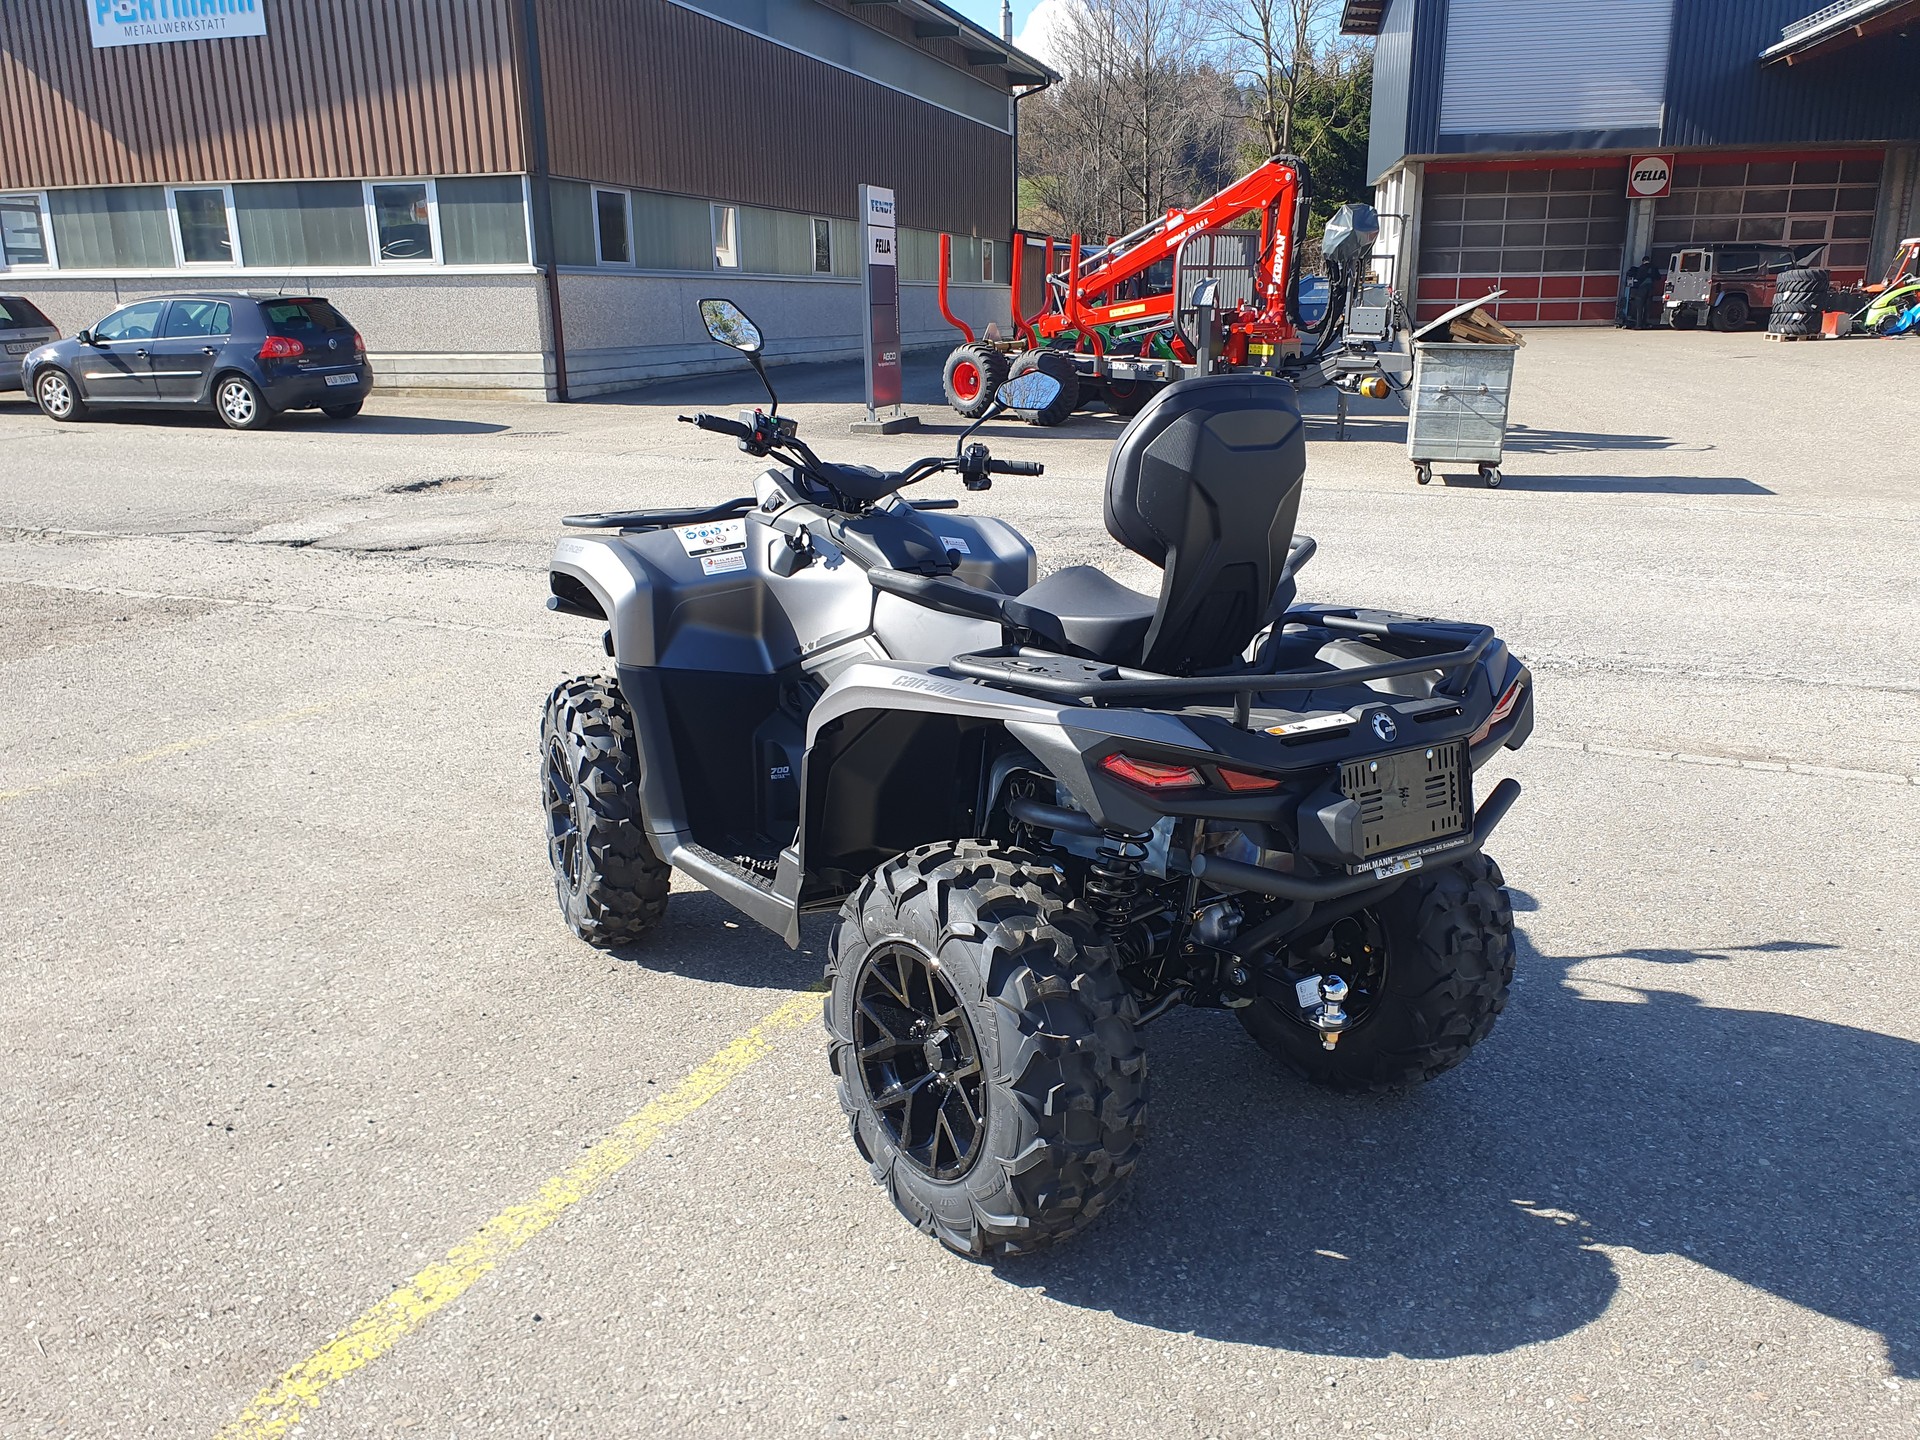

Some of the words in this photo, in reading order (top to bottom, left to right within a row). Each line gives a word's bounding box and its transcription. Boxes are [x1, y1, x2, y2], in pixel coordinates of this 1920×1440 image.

[124, 17, 226, 37] METALLWERKSTATT
[1633, 169, 1667, 181] FELLA
[875, 238, 891, 254] FELLA
[1272, 233, 1286, 285] KRPAN
[883, 352, 896, 361] AGCO
[770, 766, 790, 774] 700
[1357, 856, 1393, 873] ZIHLMANN
